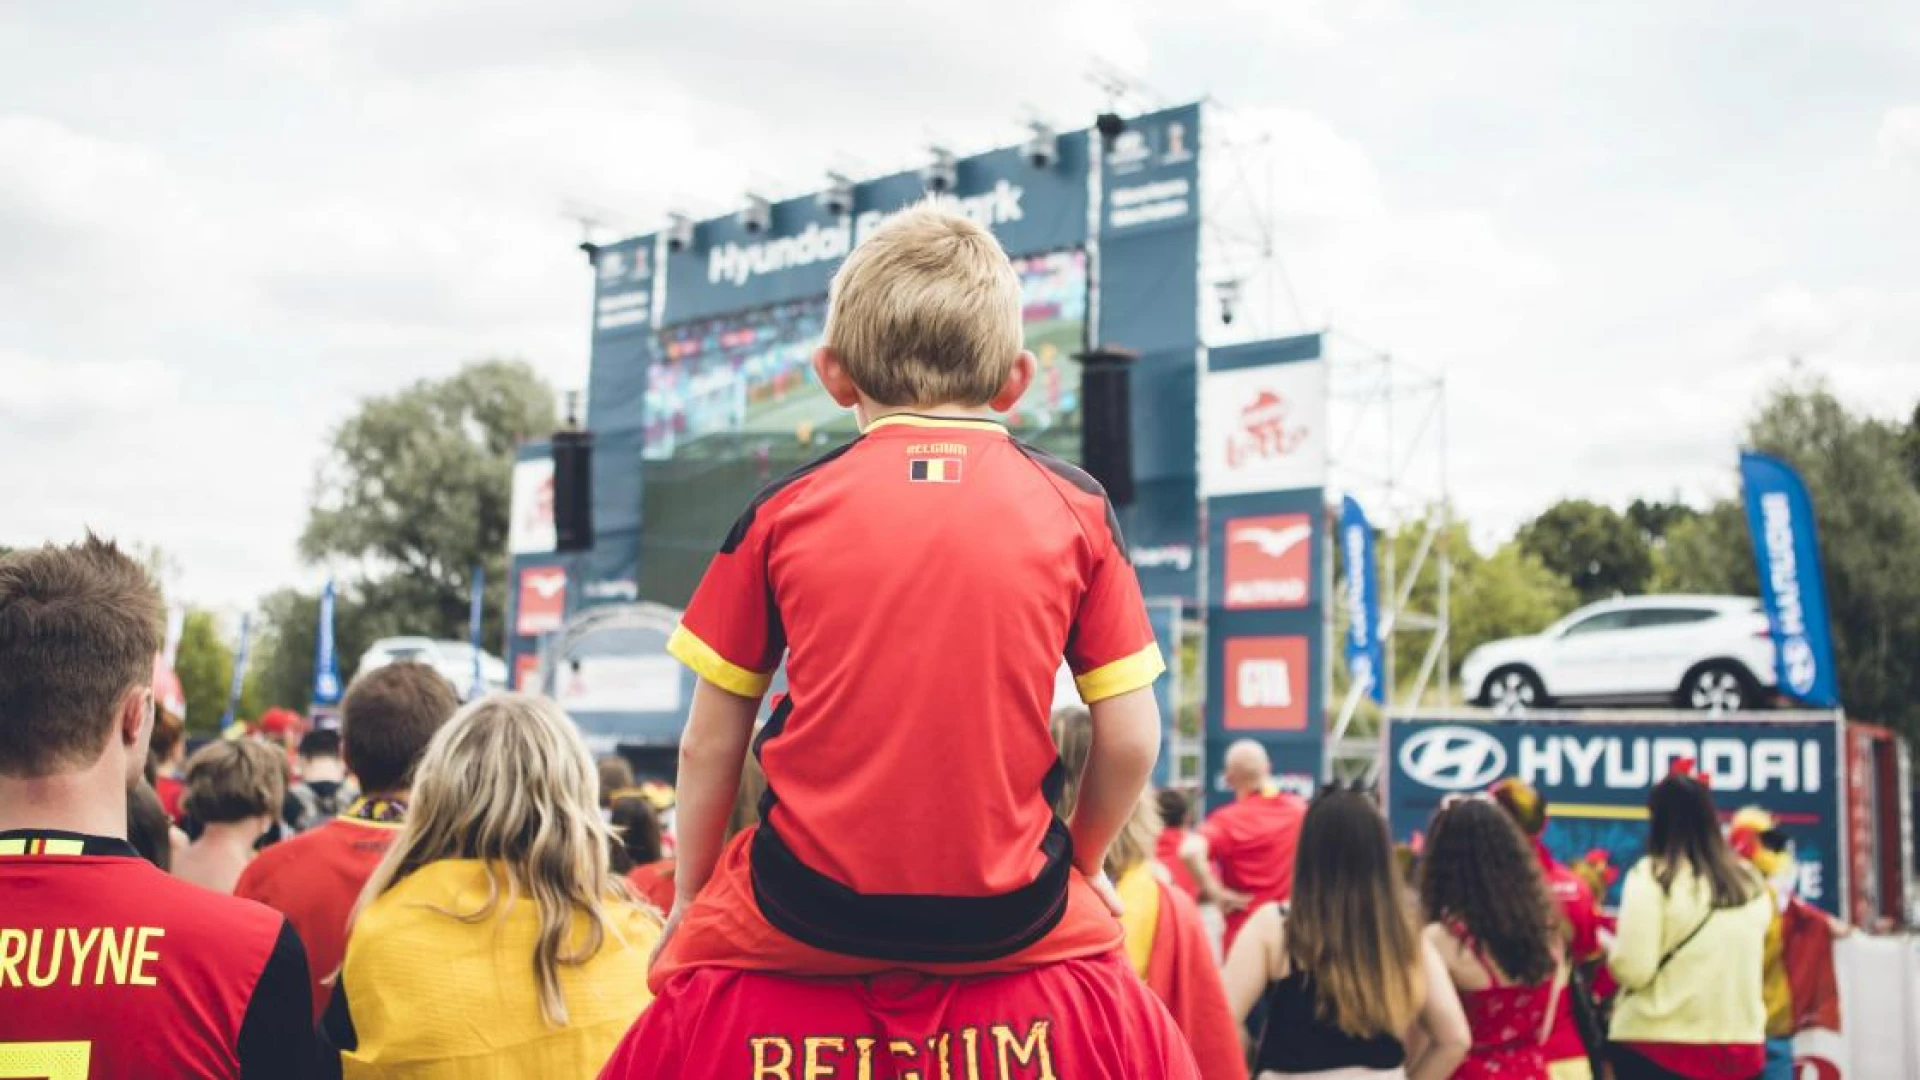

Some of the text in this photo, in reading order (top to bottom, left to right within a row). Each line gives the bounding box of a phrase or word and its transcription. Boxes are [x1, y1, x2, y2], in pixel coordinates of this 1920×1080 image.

[1517, 733, 1822, 793] HYUNDAI
[0, 926, 165, 988] RUYNE
[749, 1020, 1057, 1080] BELGUM
